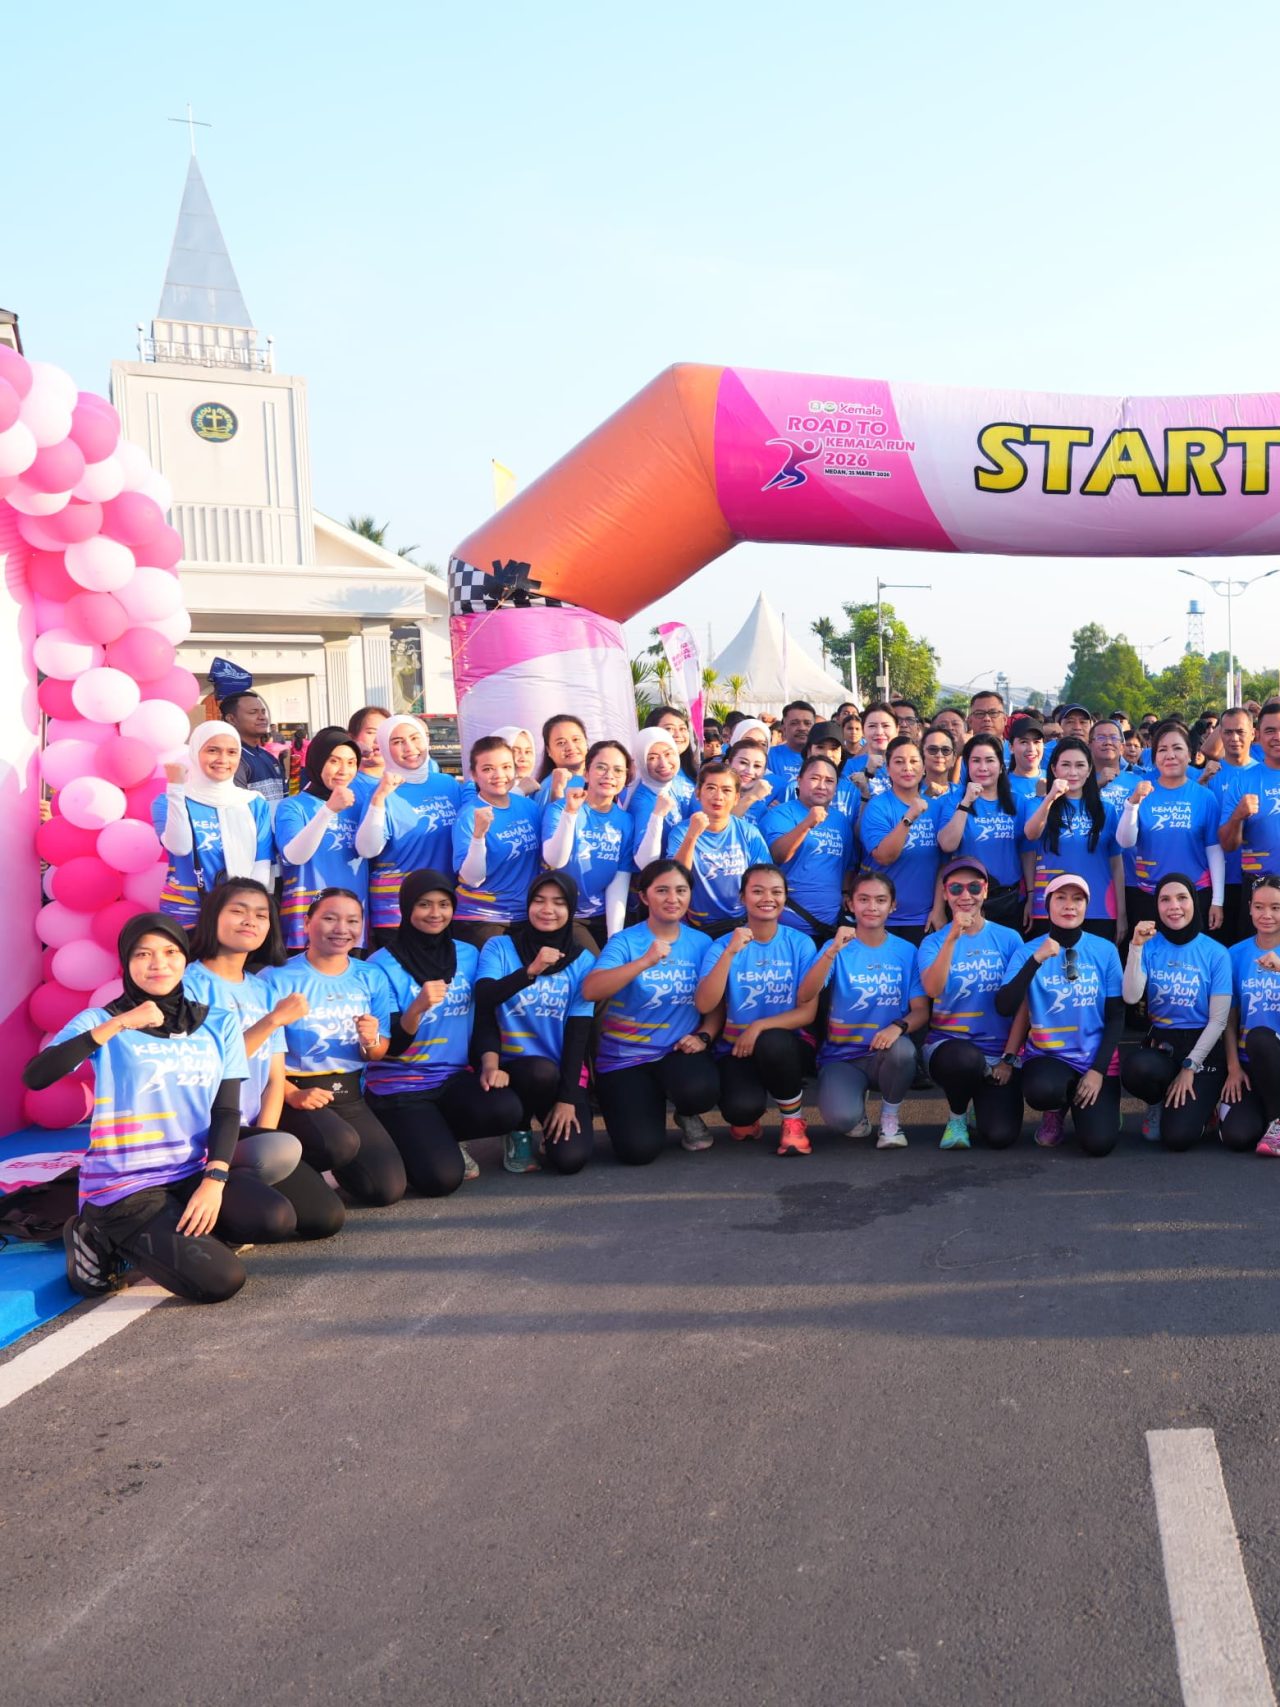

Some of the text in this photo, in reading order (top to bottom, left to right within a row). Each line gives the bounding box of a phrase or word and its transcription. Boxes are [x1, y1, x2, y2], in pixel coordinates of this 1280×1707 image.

[841, 403, 883, 415] Kemala
[788, 417, 887, 436] ROAD TO
[826, 437, 916, 452] KEMALA RUN
[825, 453, 868, 467] 2026
[413, 800, 452, 815] KEMALA
[1151, 806, 1191, 815] KEMALA
[439, 809, 457, 820] RUN
[974, 816, 1014, 826] KEMALA
[1172, 814, 1191, 822] RUN
[496, 823, 533, 840] KEMALA
[910, 820, 935, 832] MALA
[997, 824, 1015, 833] RUN
[1169, 821, 1191, 830] 2026
[522, 832, 537, 844] RUN
[579, 830, 622, 843] KEMALA
[920, 831, 935, 840] RUN
[601, 841, 621, 852] RUN
[950, 957, 1003, 973] KEMALA
[641, 968, 698, 982] KEMALA
[737, 970, 793, 984] KEMALA
[849, 972, 902, 985] KEMALA
[980, 968, 1004, 982] RUN
[1150, 969, 1200, 988] KEMALA
[527, 979, 570, 995] MALA
[767, 981, 793, 994] RUN
[978, 983, 1001, 994] 202
[1074, 983, 1098, 998] RUN
[1173, 984, 1199, 998] RUN
[448, 988, 471, 1005] RUN
[541, 993, 568, 1008] RUN
[764, 994, 793, 1005] 2026
[876, 997, 899, 1007] 202
[1170, 997, 1197, 1008] 2026
[133, 1041, 218, 1057] KEMALA
[185, 1055, 218, 1075] RUN
